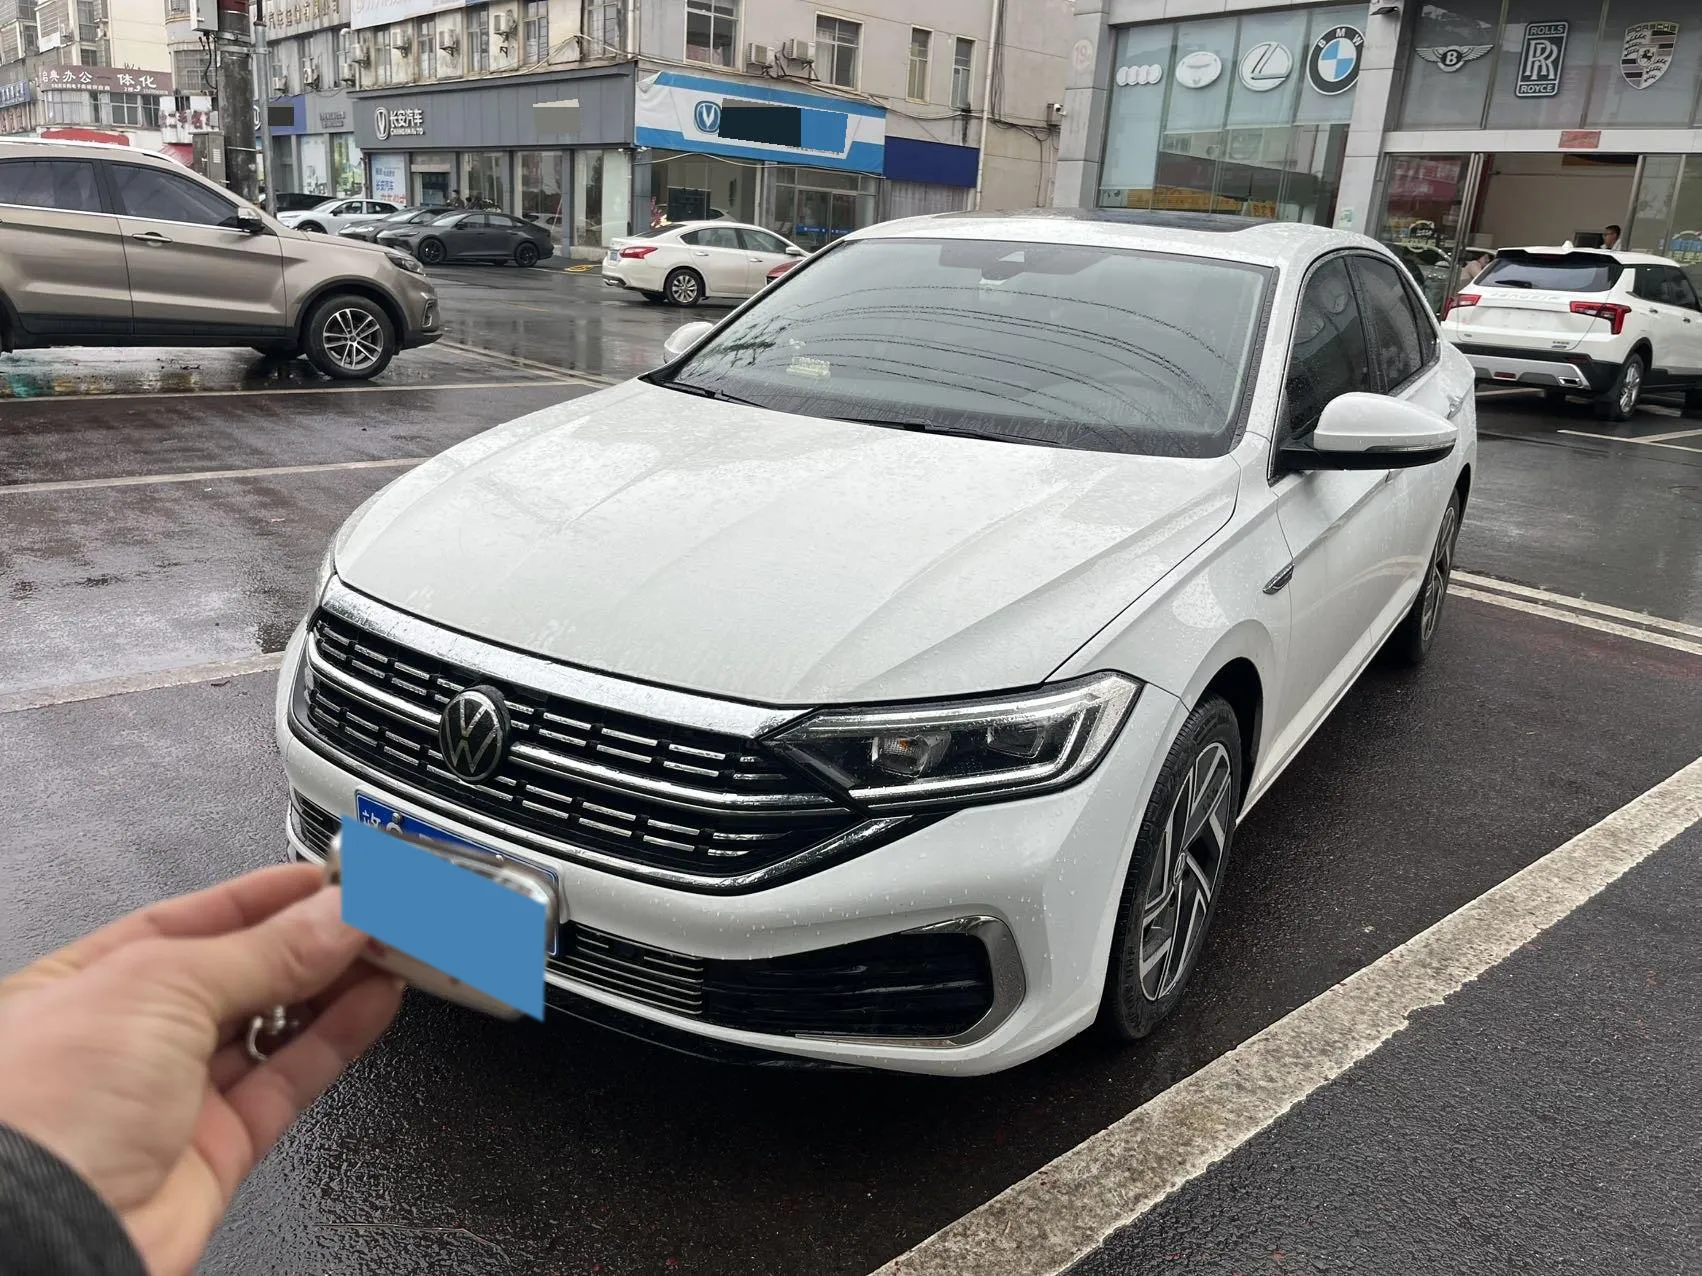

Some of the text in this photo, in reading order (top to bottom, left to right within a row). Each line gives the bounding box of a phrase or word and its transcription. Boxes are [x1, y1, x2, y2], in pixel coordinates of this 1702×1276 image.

[1530, 25, 1564, 35] ROLLS
[1318, 28, 1364, 48] BMW
[1520, 84, 1553, 93] ROYCE
[390, 109, 423, 127] 长安汽车
